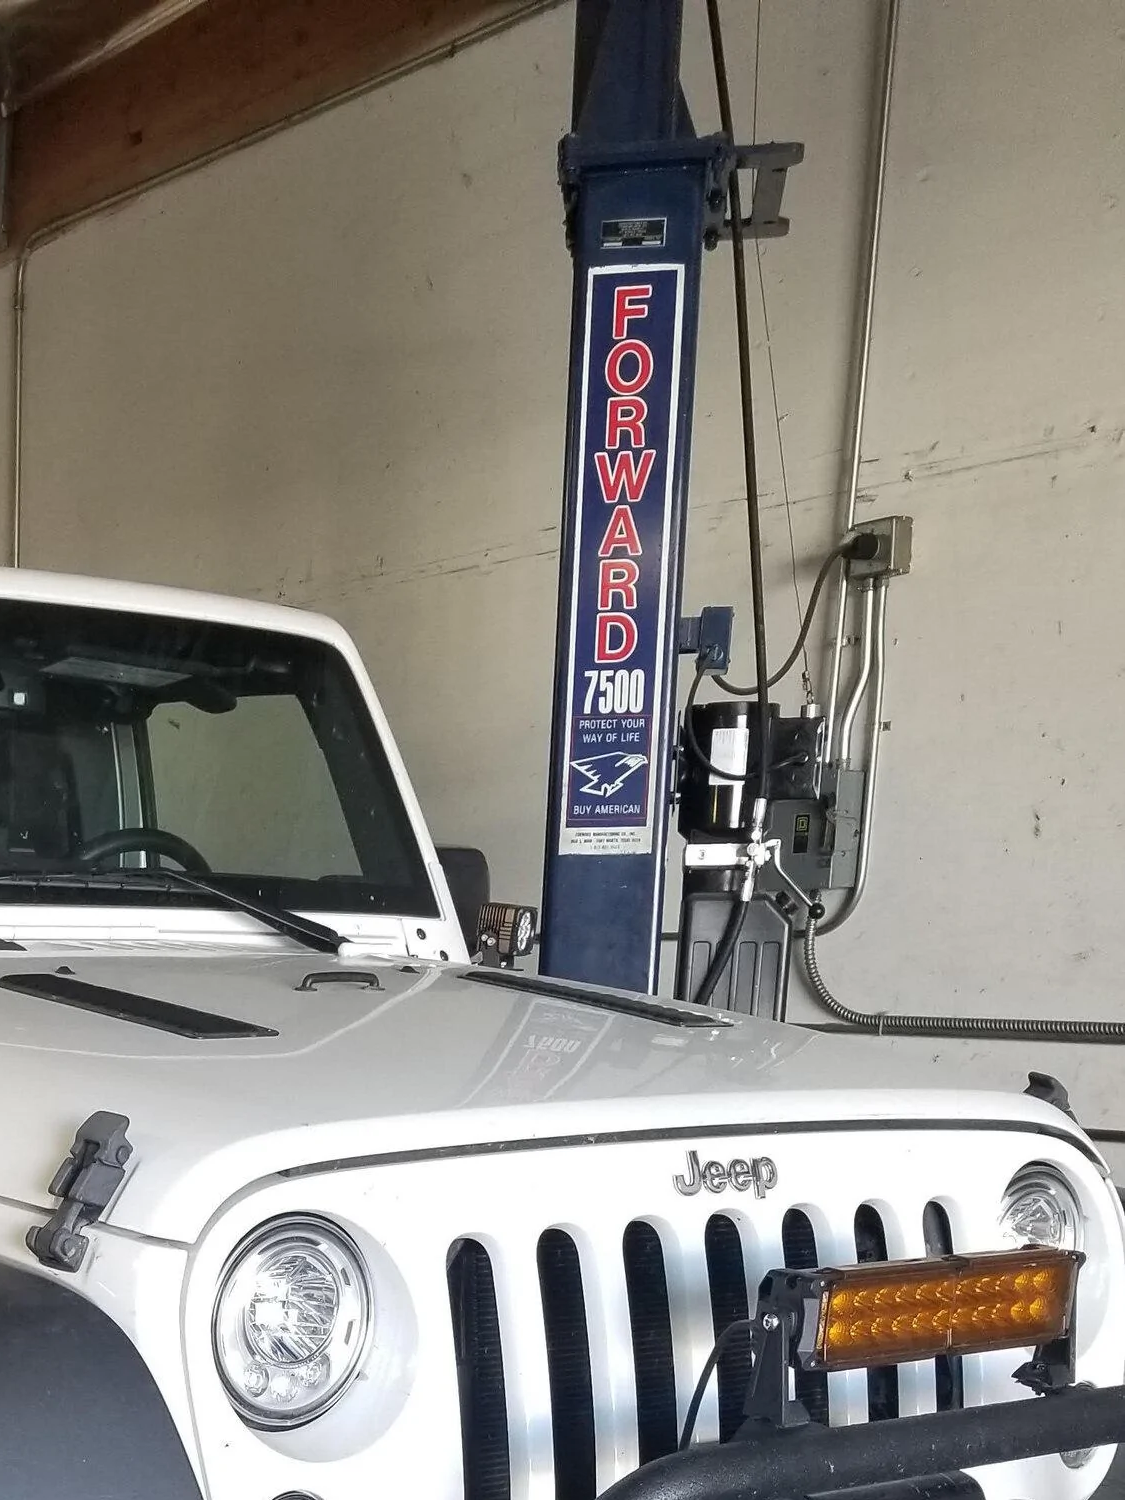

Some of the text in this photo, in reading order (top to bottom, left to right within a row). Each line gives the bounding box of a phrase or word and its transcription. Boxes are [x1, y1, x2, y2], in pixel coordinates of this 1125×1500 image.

[594, 284, 657, 664] FORWARD
[583, 668, 645, 714] 7500
[579, 718, 645, 730] PROTECT YOUR
[582, 732, 640, 743] WAY OF LIFE
[573, 804, 641, 815] BUY AMERICAN
[671, 1150, 779, 1200] Jeep
